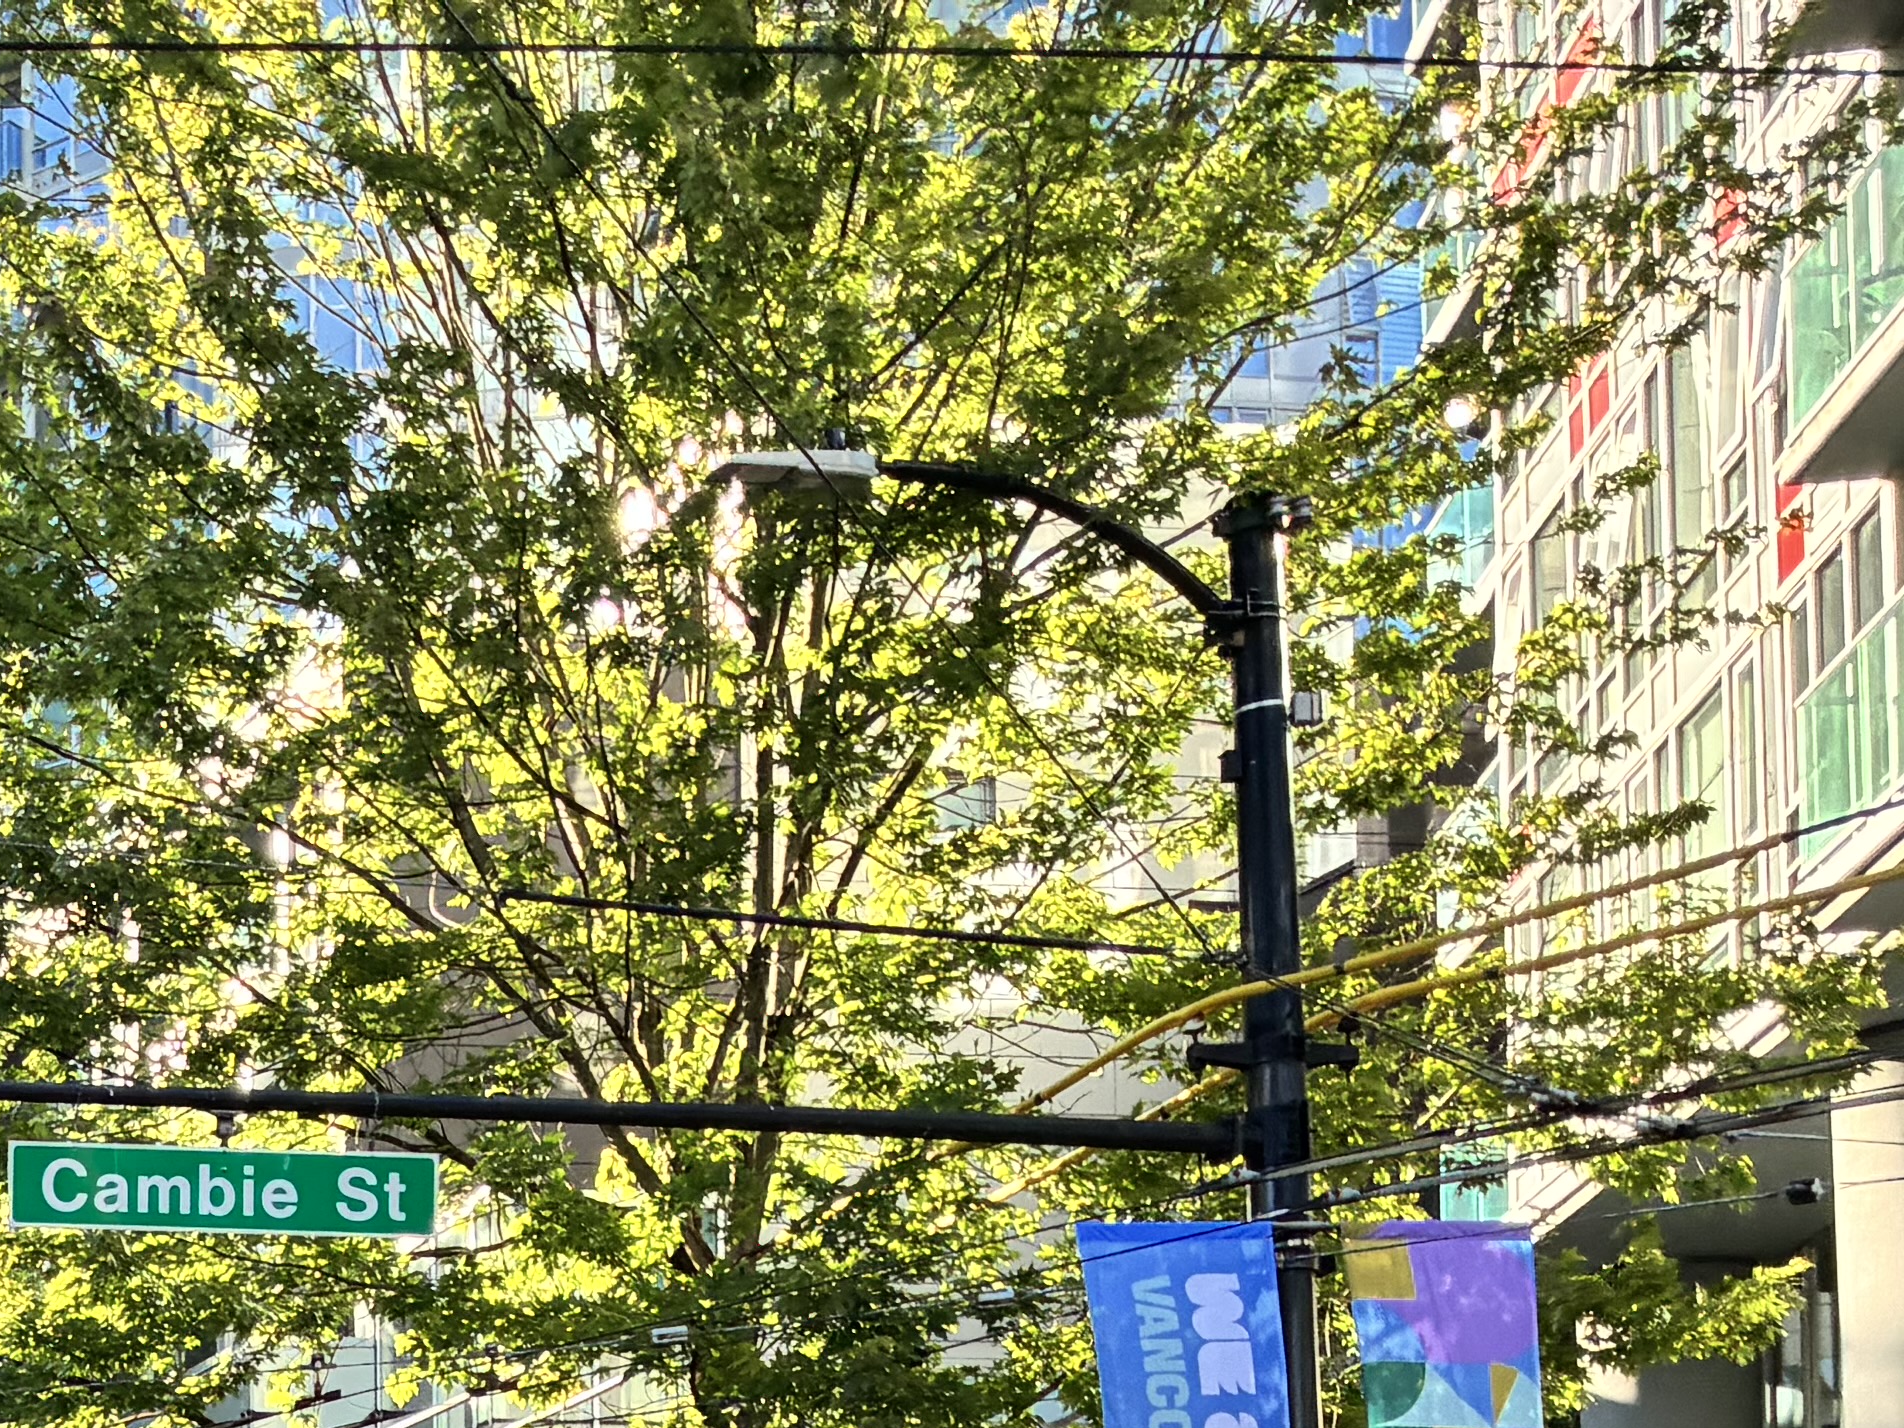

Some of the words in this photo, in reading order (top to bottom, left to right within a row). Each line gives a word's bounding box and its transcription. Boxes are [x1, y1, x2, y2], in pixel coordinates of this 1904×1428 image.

[41, 1157, 299, 1220] Cambie
[335, 1167, 407, 1223] St
[1185, 1272, 1257, 1396] WE
